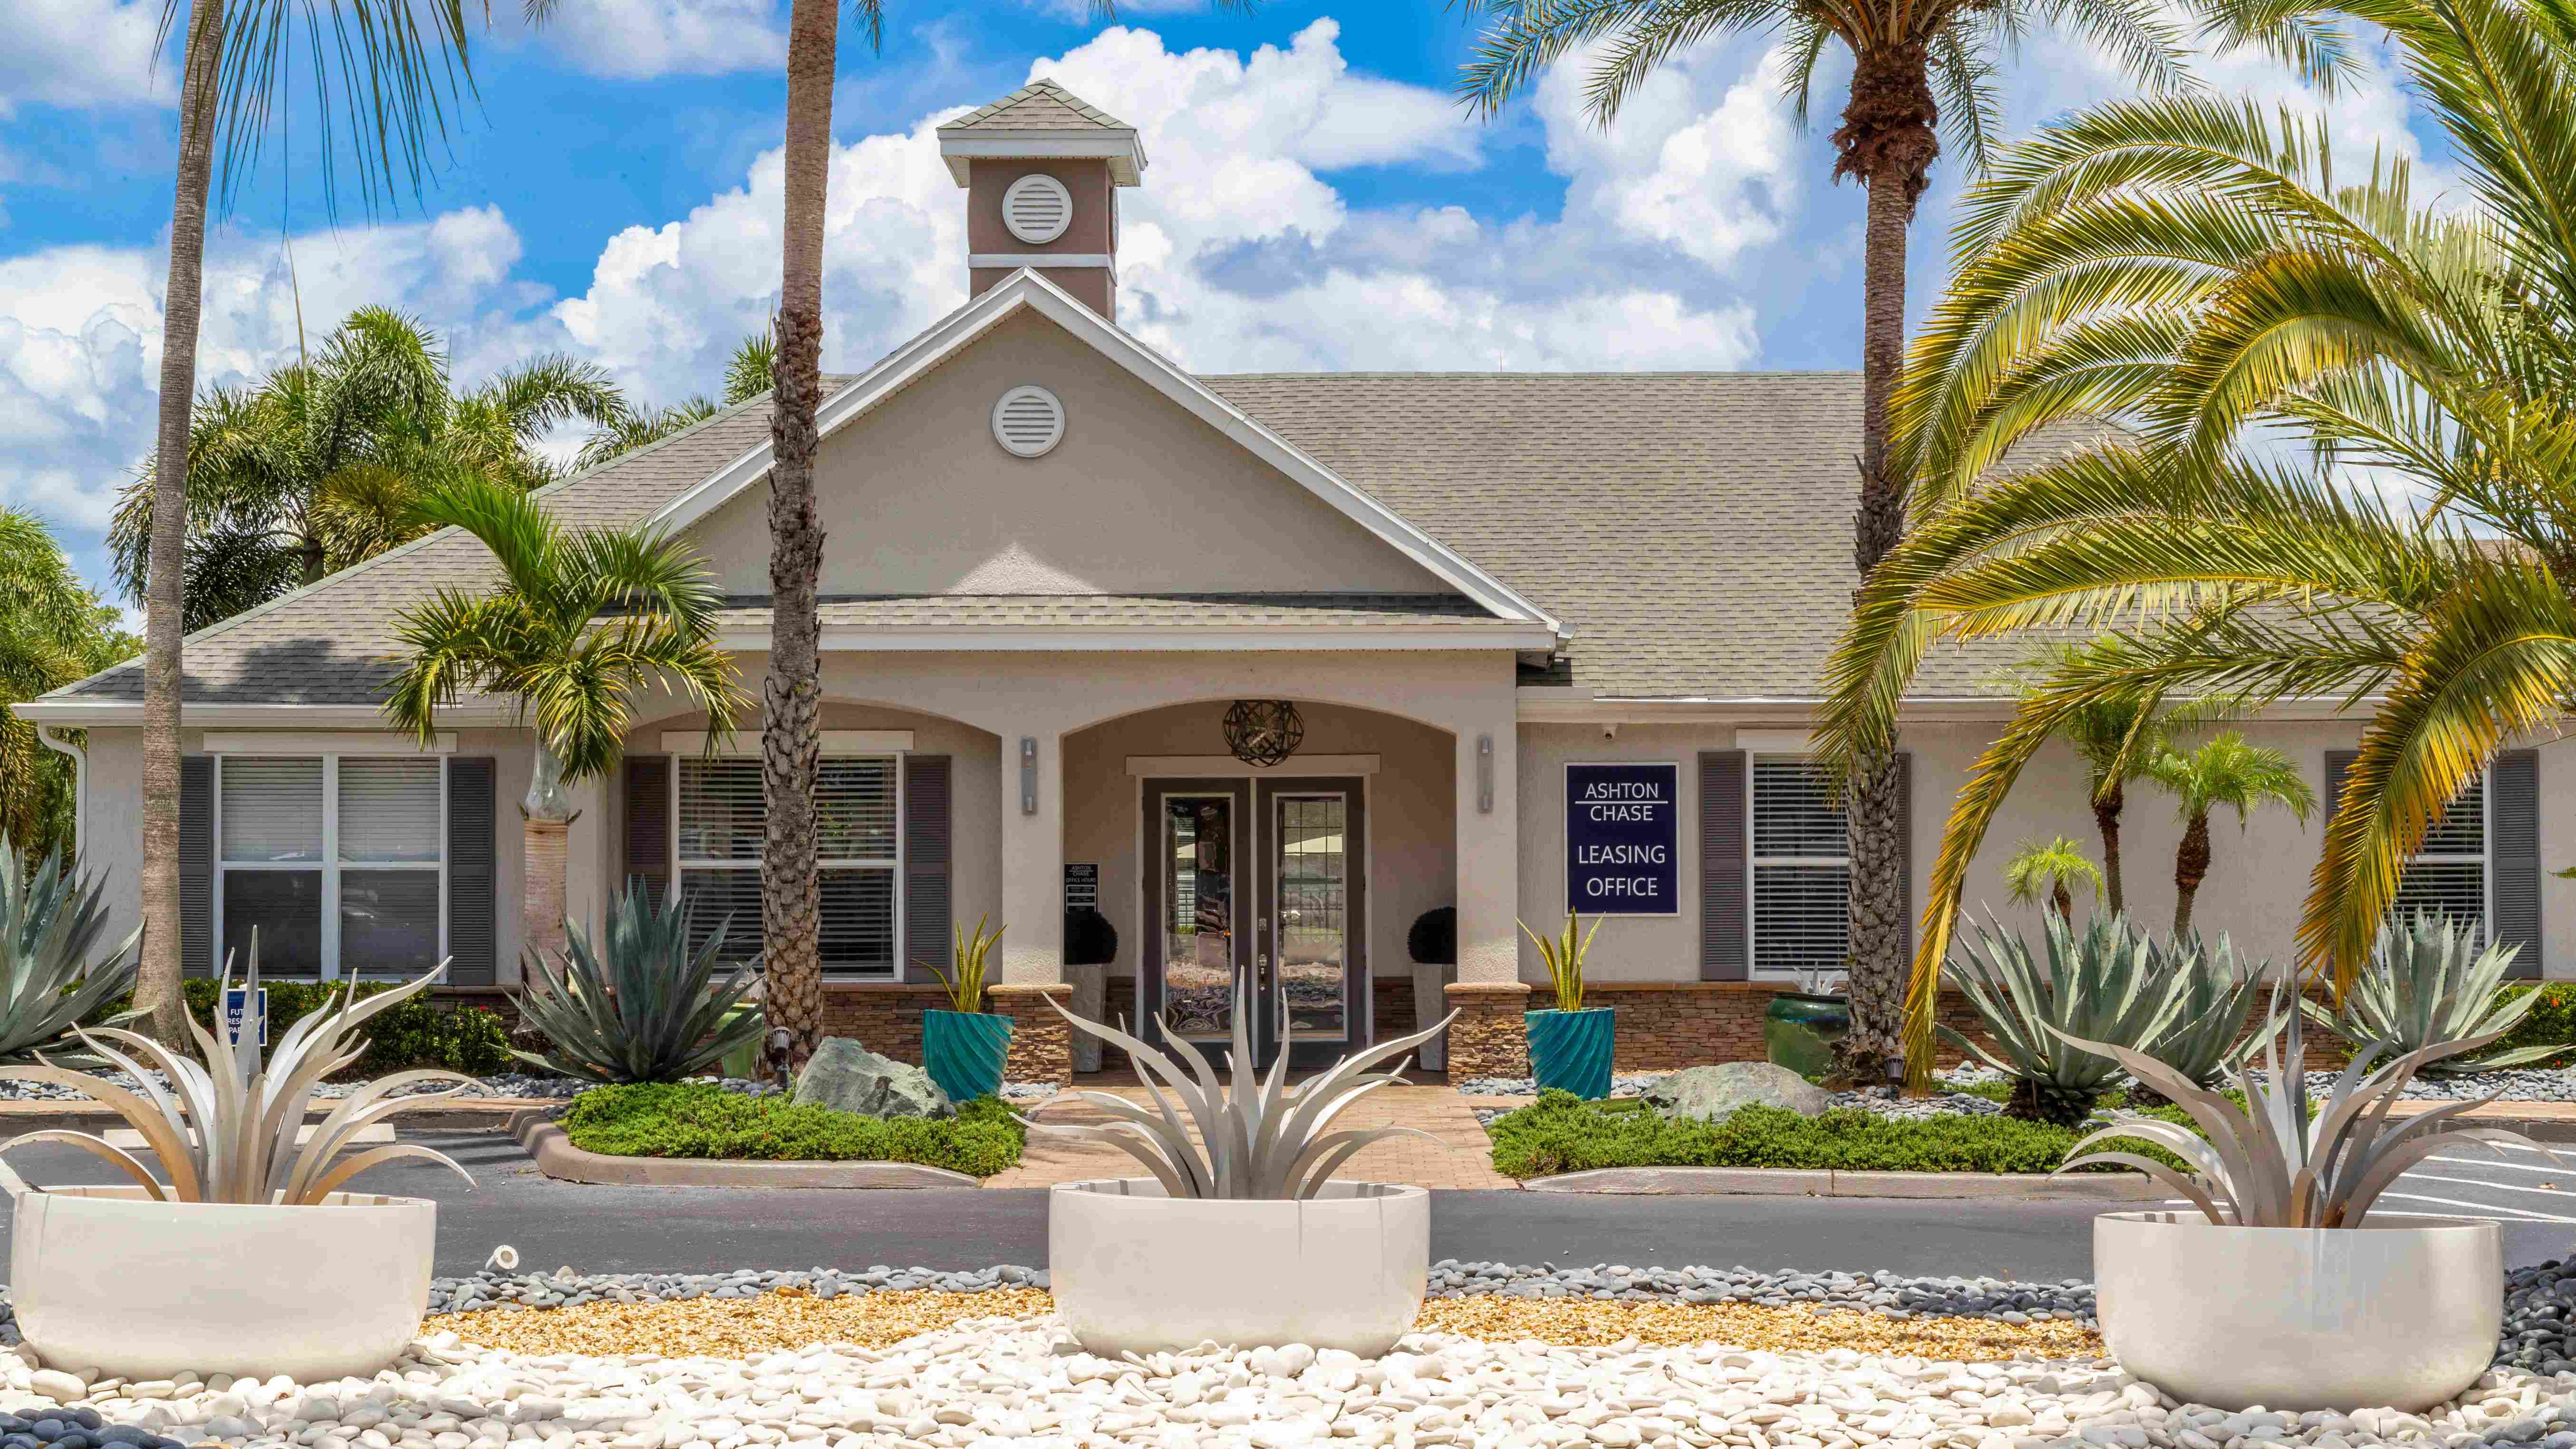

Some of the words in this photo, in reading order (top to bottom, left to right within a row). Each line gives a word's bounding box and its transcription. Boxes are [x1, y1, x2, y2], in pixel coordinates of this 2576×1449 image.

[1585, 783, 1658, 798] ASHTON
[1591, 806, 1653, 821] CHASE
[1579, 845, 1665, 864] LEASING
[1586, 878, 1658, 896] OFFICE
